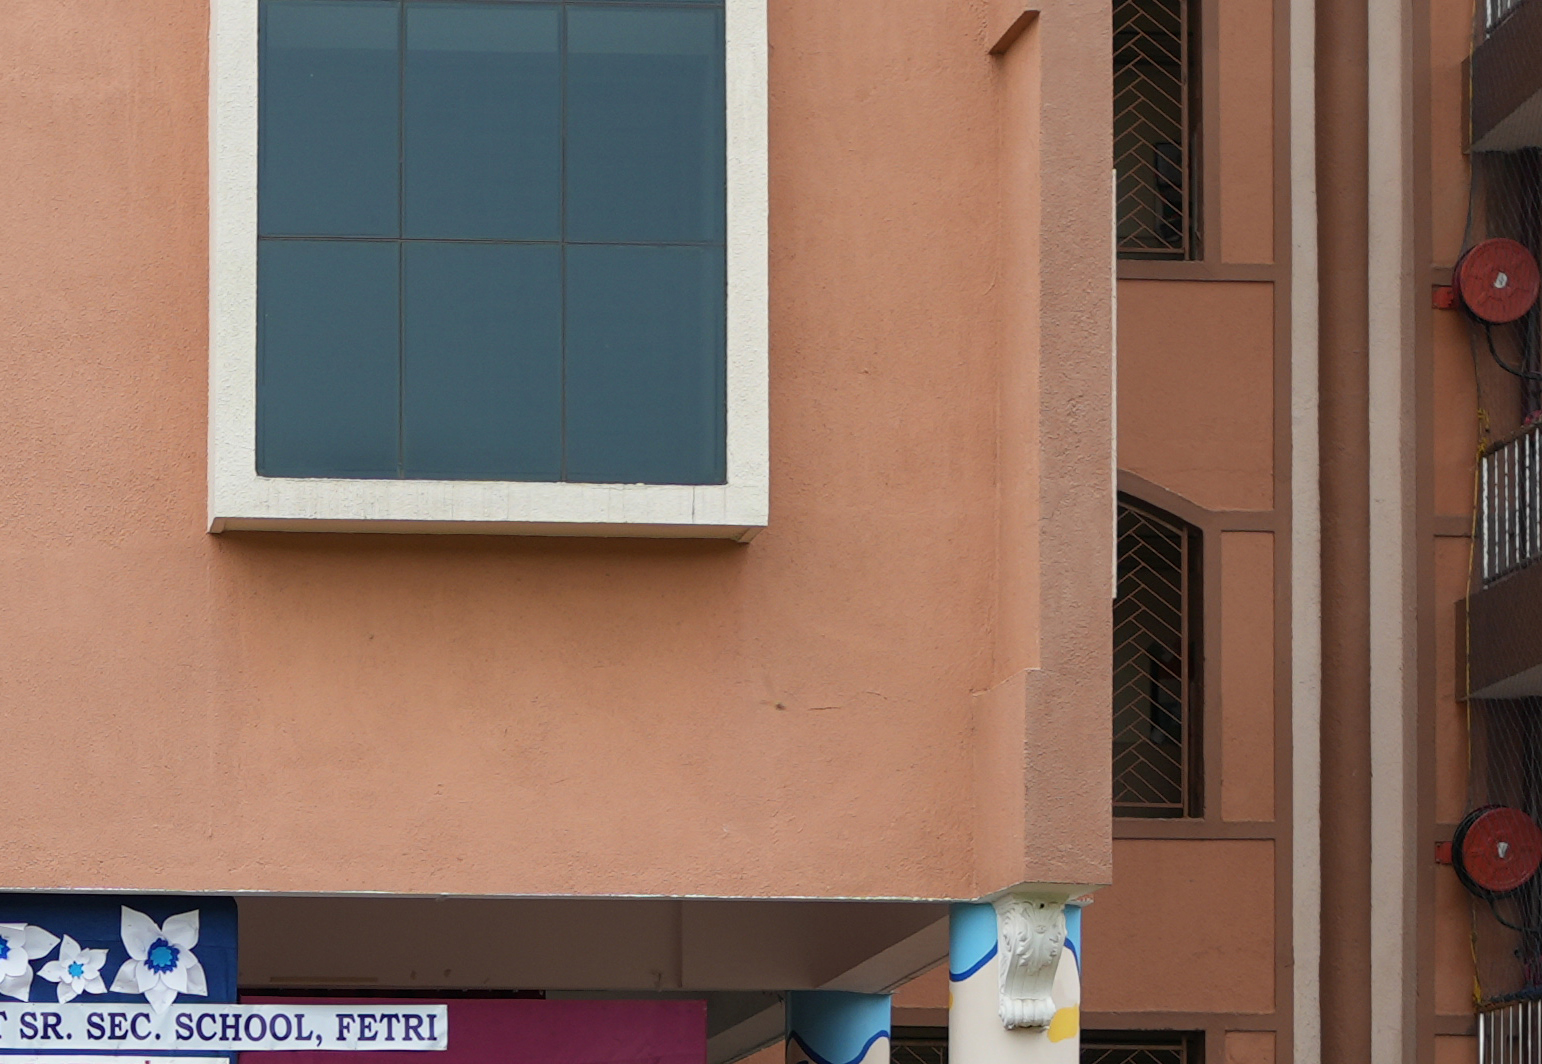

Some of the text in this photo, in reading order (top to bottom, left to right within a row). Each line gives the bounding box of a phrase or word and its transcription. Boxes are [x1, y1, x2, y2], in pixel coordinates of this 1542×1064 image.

[19, 1011, 72, 1041] SR.
[86, 1012, 161, 1041] SEC.
[174, 1012, 323, 1047] SCHOOL,
[335, 1013, 438, 1043] FETRI
